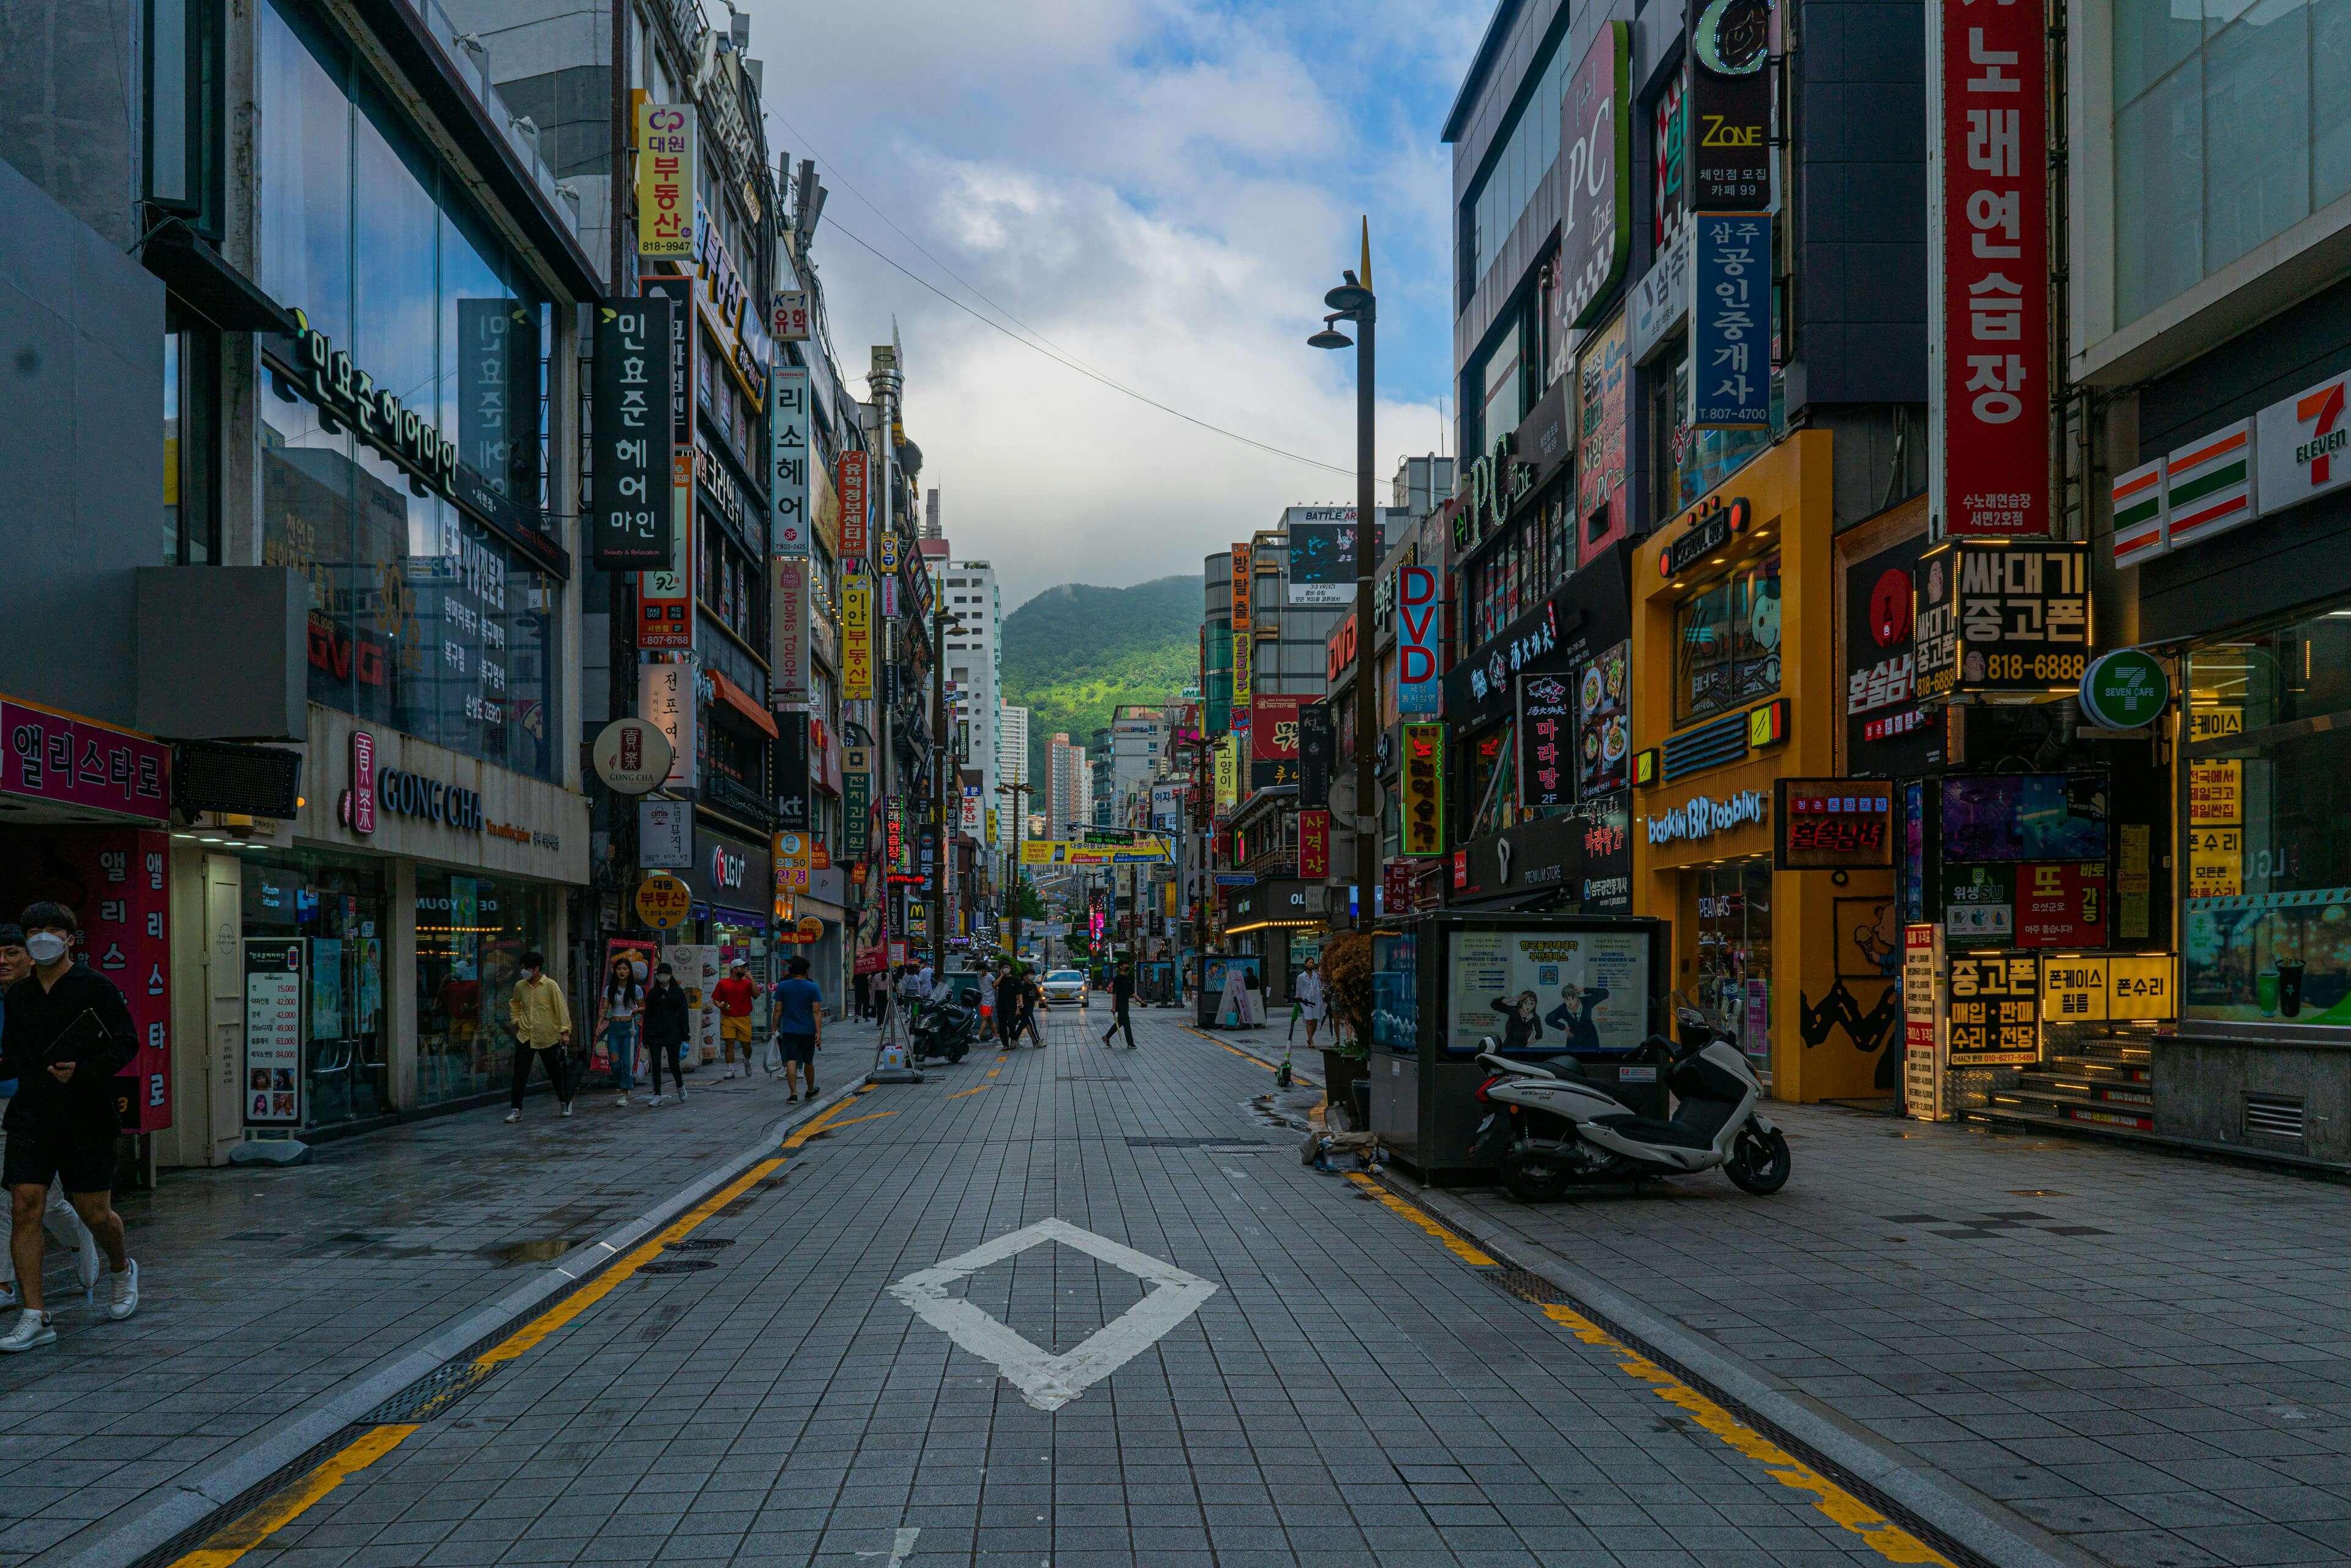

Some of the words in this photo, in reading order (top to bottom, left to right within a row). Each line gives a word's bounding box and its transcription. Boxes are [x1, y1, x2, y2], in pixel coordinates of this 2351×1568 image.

[1701, 114, 1762, 146] ZONE
[648, 137, 685, 153] 대원
[1564, 97, 1610, 240] PC
[1700, 169, 1738, 181] 체인점
[1741, 168, 1766, 180] 모집
[654, 157, 682, 238] 부동산
[1711, 185, 1735, 197] 카페
[1740, 185, 1756, 196] 99
[1966, 0, 2027, 424] 노래연습장
[1708, 222, 1760, 245] 삼주
[642, 241, 691, 252] 818-9947
[773, 293, 806, 307] K-1
[774, 309, 807, 335] 유학
[1711, 249, 1755, 405] 공인중개사
[1699, 408, 1767, 420] T.807-4700
[777, 388, 805, 523] 리소헤어
[842, 452, 864, 462] K-1
[1469, 432, 1509, 553] PC
[1962, 493, 2031, 509] 수노래연습장
[1306, 512, 1342, 520] BATTLE
[1343, 512, 1358, 520] AR
[1970, 511, 2023, 527] 서면2호점
[784, 530, 797, 540] 3F
[1962, 552, 2085, 595] 싸대기
[1234, 555, 1248, 620] 방탈출
[1400, 567, 1436, 684] DVD
[1917, 602, 1955, 643] 싸대기
[1963, 599, 2085, 642] 중고폰
[642, 636, 689, 645] T.807-6768
[784, 635, 797, 677] TOUCH
[1917, 632, 1955, 673] 중고폰
[1987, 653, 2085, 681] 818-6888
[1409, 685, 1427, 694] 극장
[1916, 667, 1955, 698] 818-6888
[2105, 686, 2131, 697] SEVEN
[2134, 686, 2154, 697] CAFE
[1402, 694, 1436, 704] 동시상영
[484, 704, 501, 724] ZERO
[12, 723, 162, 800] 앨리스타로
[1536, 718, 1560, 790] 마라탕
[610, 773, 635, 782] GONG
[636, 774, 654, 782] CHA
[1220, 745, 1232, 788] 고양이
[379, 767, 443, 823] GONG
[443, 785, 485, 831] CHA
[779, 795, 804, 816] kt
[963, 797, 977, 823] 부동산
[1541, 794, 1558, 804] 2F
[1687, 795, 1710, 840] BR
[1305, 816, 1326, 874] 사격장
[1584, 824, 1613, 857] 마라탕
[1613, 825, 1624, 851] 2F
[776, 858, 806, 868] 으뜸50
[2195, 866, 2228, 879] 모든폰
[775, 869, 807, 885] 안경
[1525, 868, 1547, 885] PREMIUM
[1547, 864, 1562, 880] STORE
[2031, 866, 2064, 897] 또
[640, 891, 686, 908] 부동산
[1392, 867, 1406, 910] 폰사랑
[1308, 901, 1321, 909] Nail
[2025, 924, 2040, 934] 아주
[146, 852, 165, 1108] 앨리스타로
[1951, 959, 2037, 997] 중고폰
[2049, 969, 2102, 990] 폰케이스
[2116, 978, 2164, 998] 폰수리
[1951, 1002, 1985, 1024] 매입
[1999, 1002, 2034, 1024] 판매
[2061, 993, 2090, 1014] 필름
[1952, 1027, 1986, 1049] 수리
[1999, 1026, 2035, 1049] 전당
[1952, 1054, 1971, 1063] 24시간
[1984, 1053, 2034, 1063] 010-6217-5486
